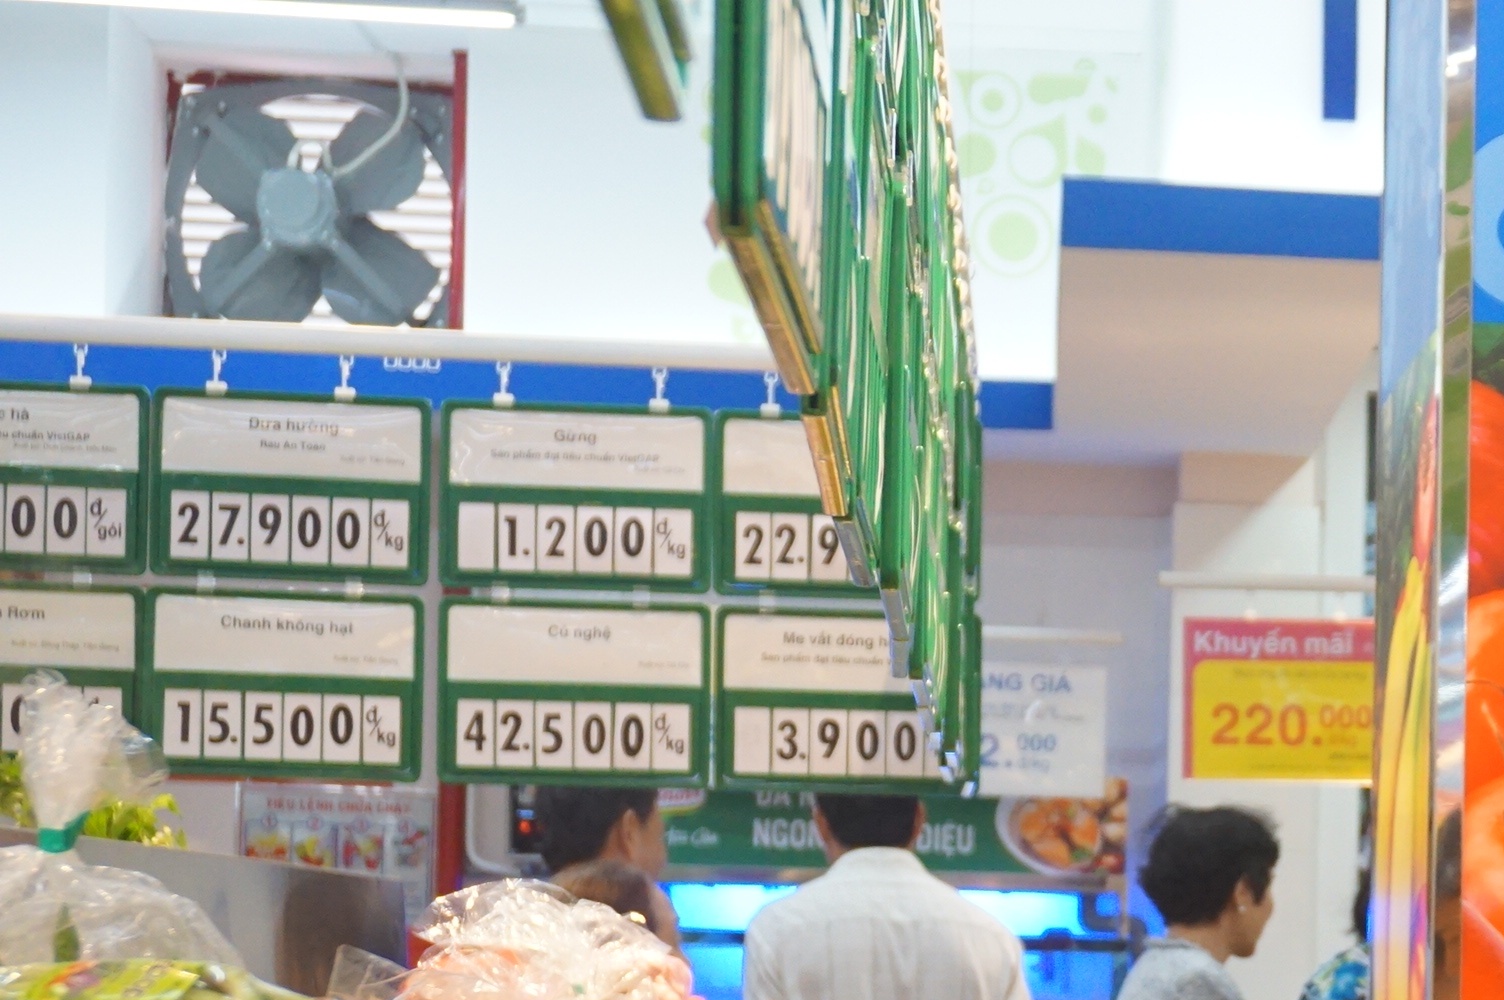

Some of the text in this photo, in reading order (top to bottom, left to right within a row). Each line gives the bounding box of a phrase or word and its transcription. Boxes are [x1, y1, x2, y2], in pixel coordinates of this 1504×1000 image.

[178, 502, 361, 550] 27.900
[504, 516, 645, 557] 1.200
[221, 615, 271, 631] Chanh
[1193, 628, 1297, 660] Khuyến
[177, 701, 354, 746] 15.500
[464, 709, 644, 757] 42.500
